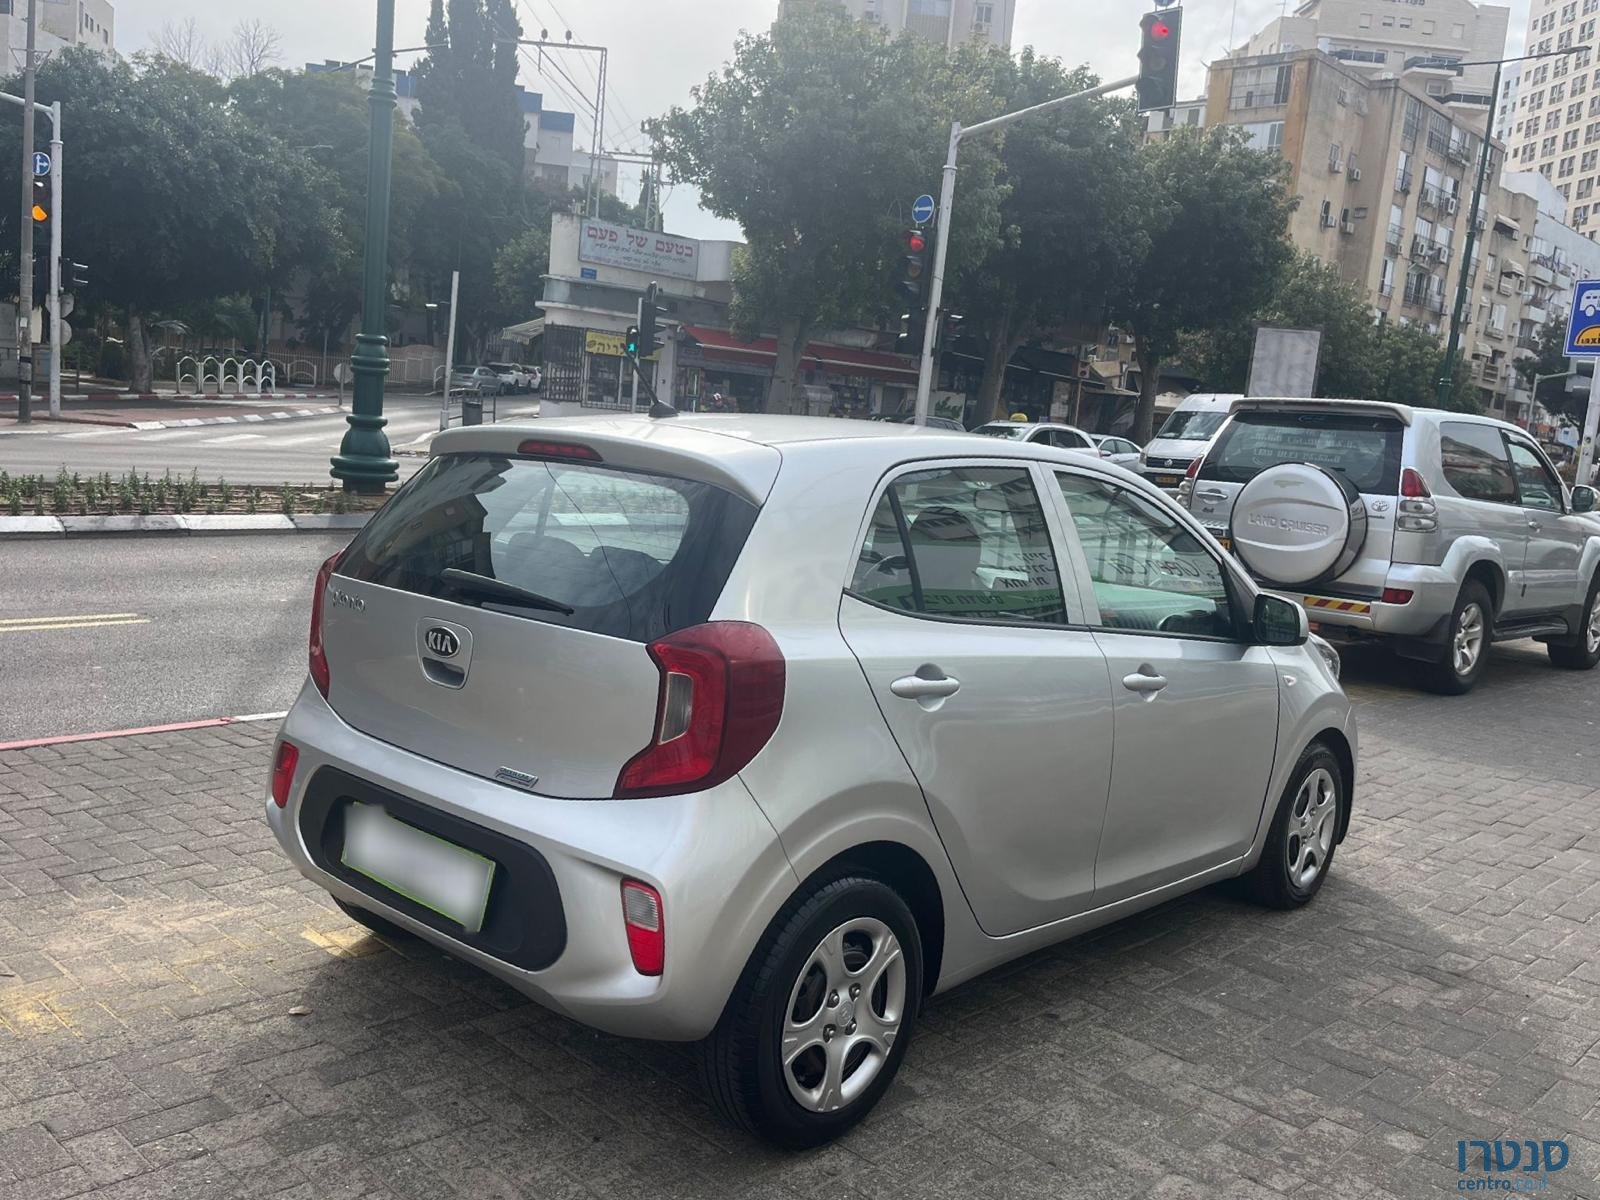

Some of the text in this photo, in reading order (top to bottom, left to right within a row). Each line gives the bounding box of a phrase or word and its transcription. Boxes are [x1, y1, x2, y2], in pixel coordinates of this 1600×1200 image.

[587, 226, 618, 243] פעם
[626, 230, 648, 249] של
[655, 240, 694, 257] בטעם
[1248, 514, 1330, 537] LAND CRUISER
[428, 631, 453, 653] KIA
